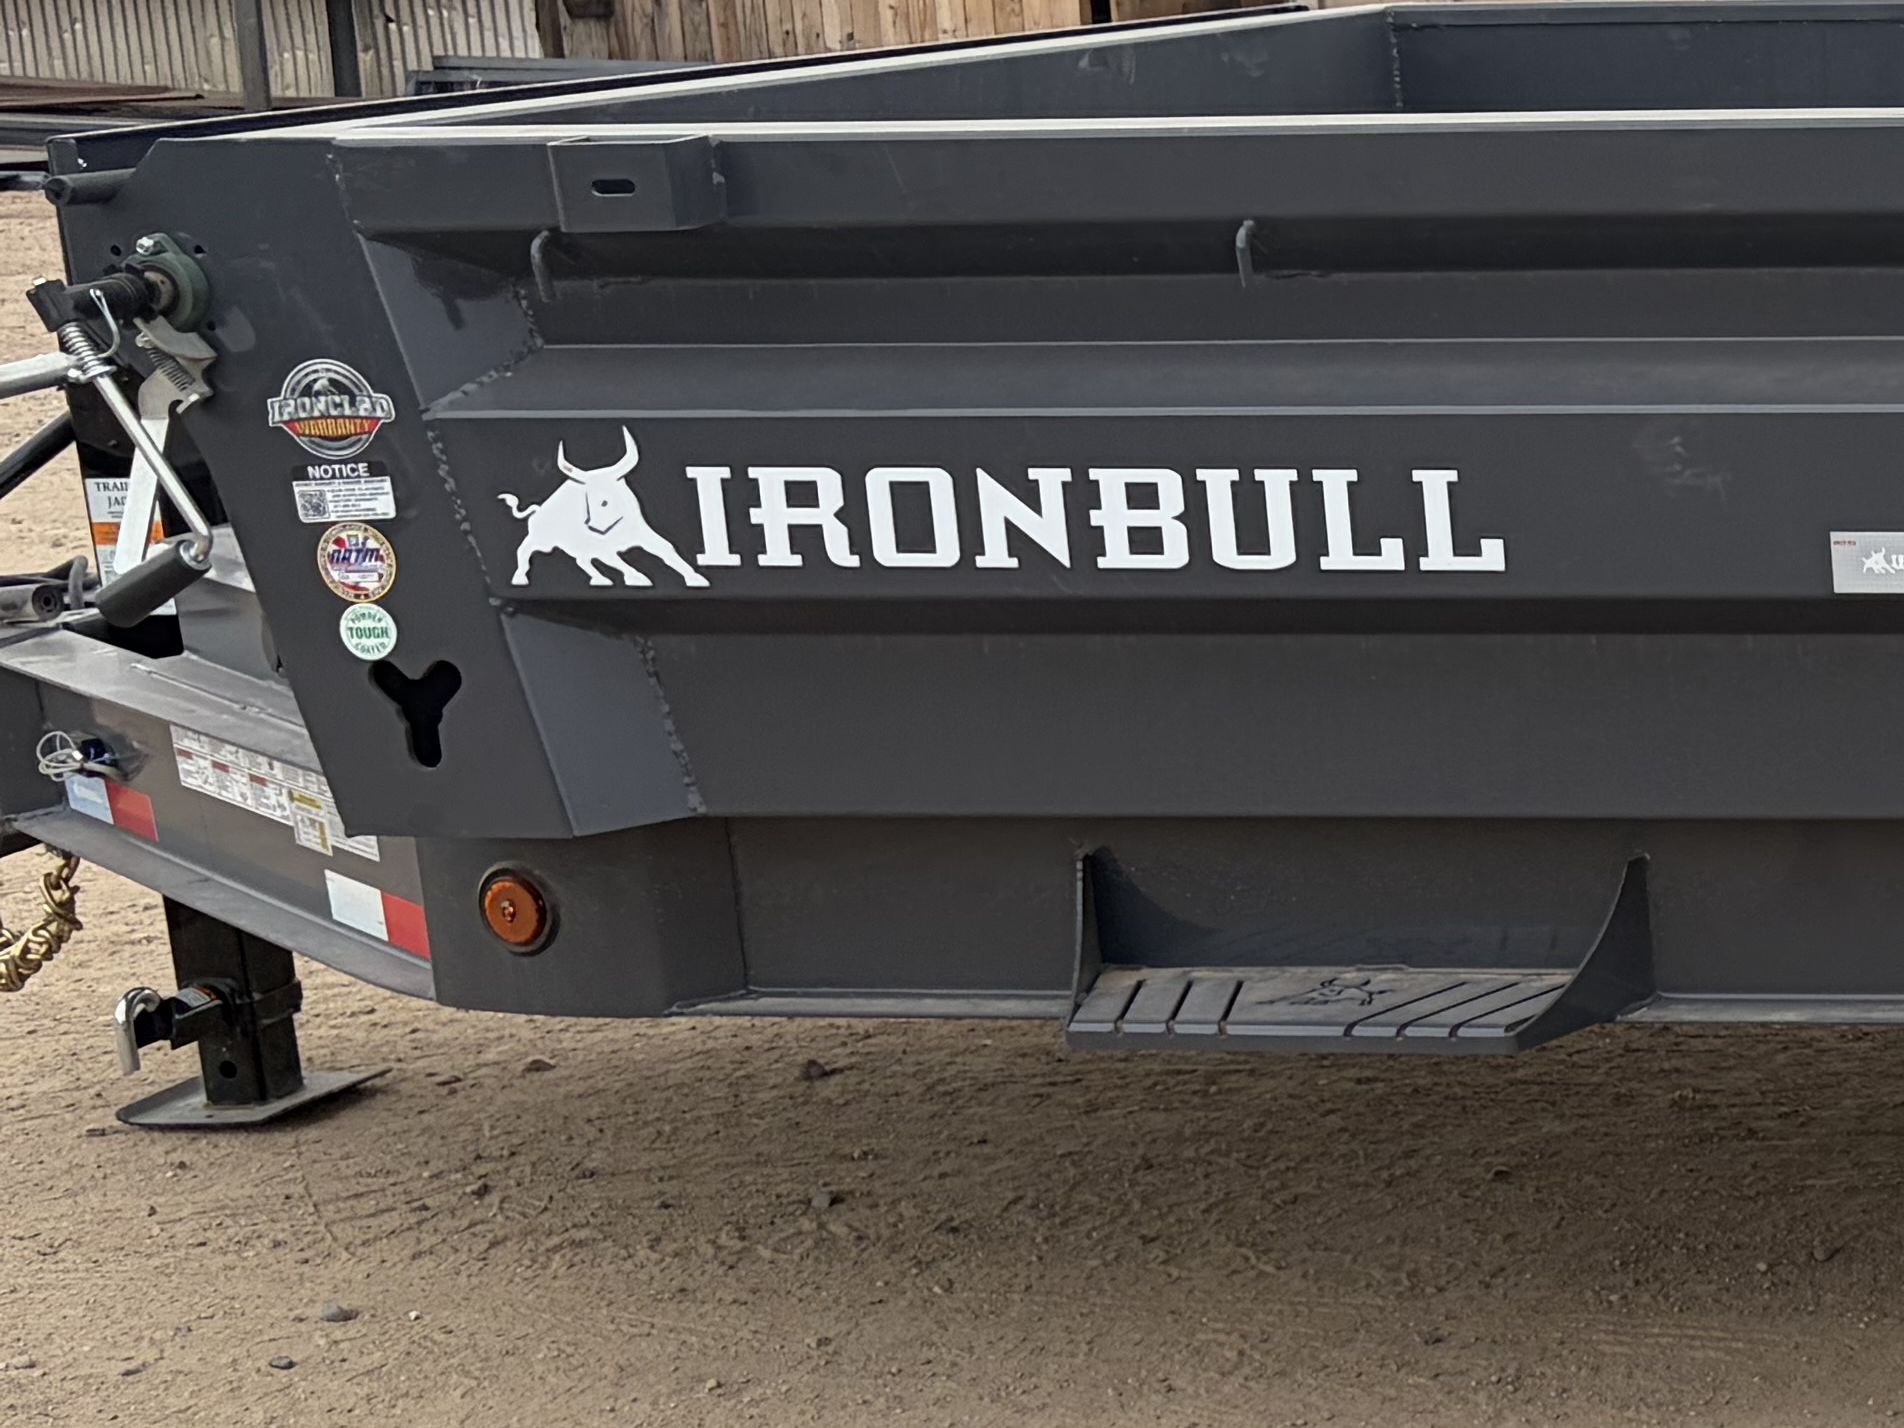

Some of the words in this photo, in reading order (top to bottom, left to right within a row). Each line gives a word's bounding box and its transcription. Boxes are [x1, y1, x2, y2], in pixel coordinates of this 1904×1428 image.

[272, 395, 391, 422] IRONCLAD
[295, 418, 371, 436] WARRANTY
[306, 462, 370, 479] NOTICE
[685, 466, 1506, 572] IRONBULL
[347, 626, 391, 639] TOUGH
